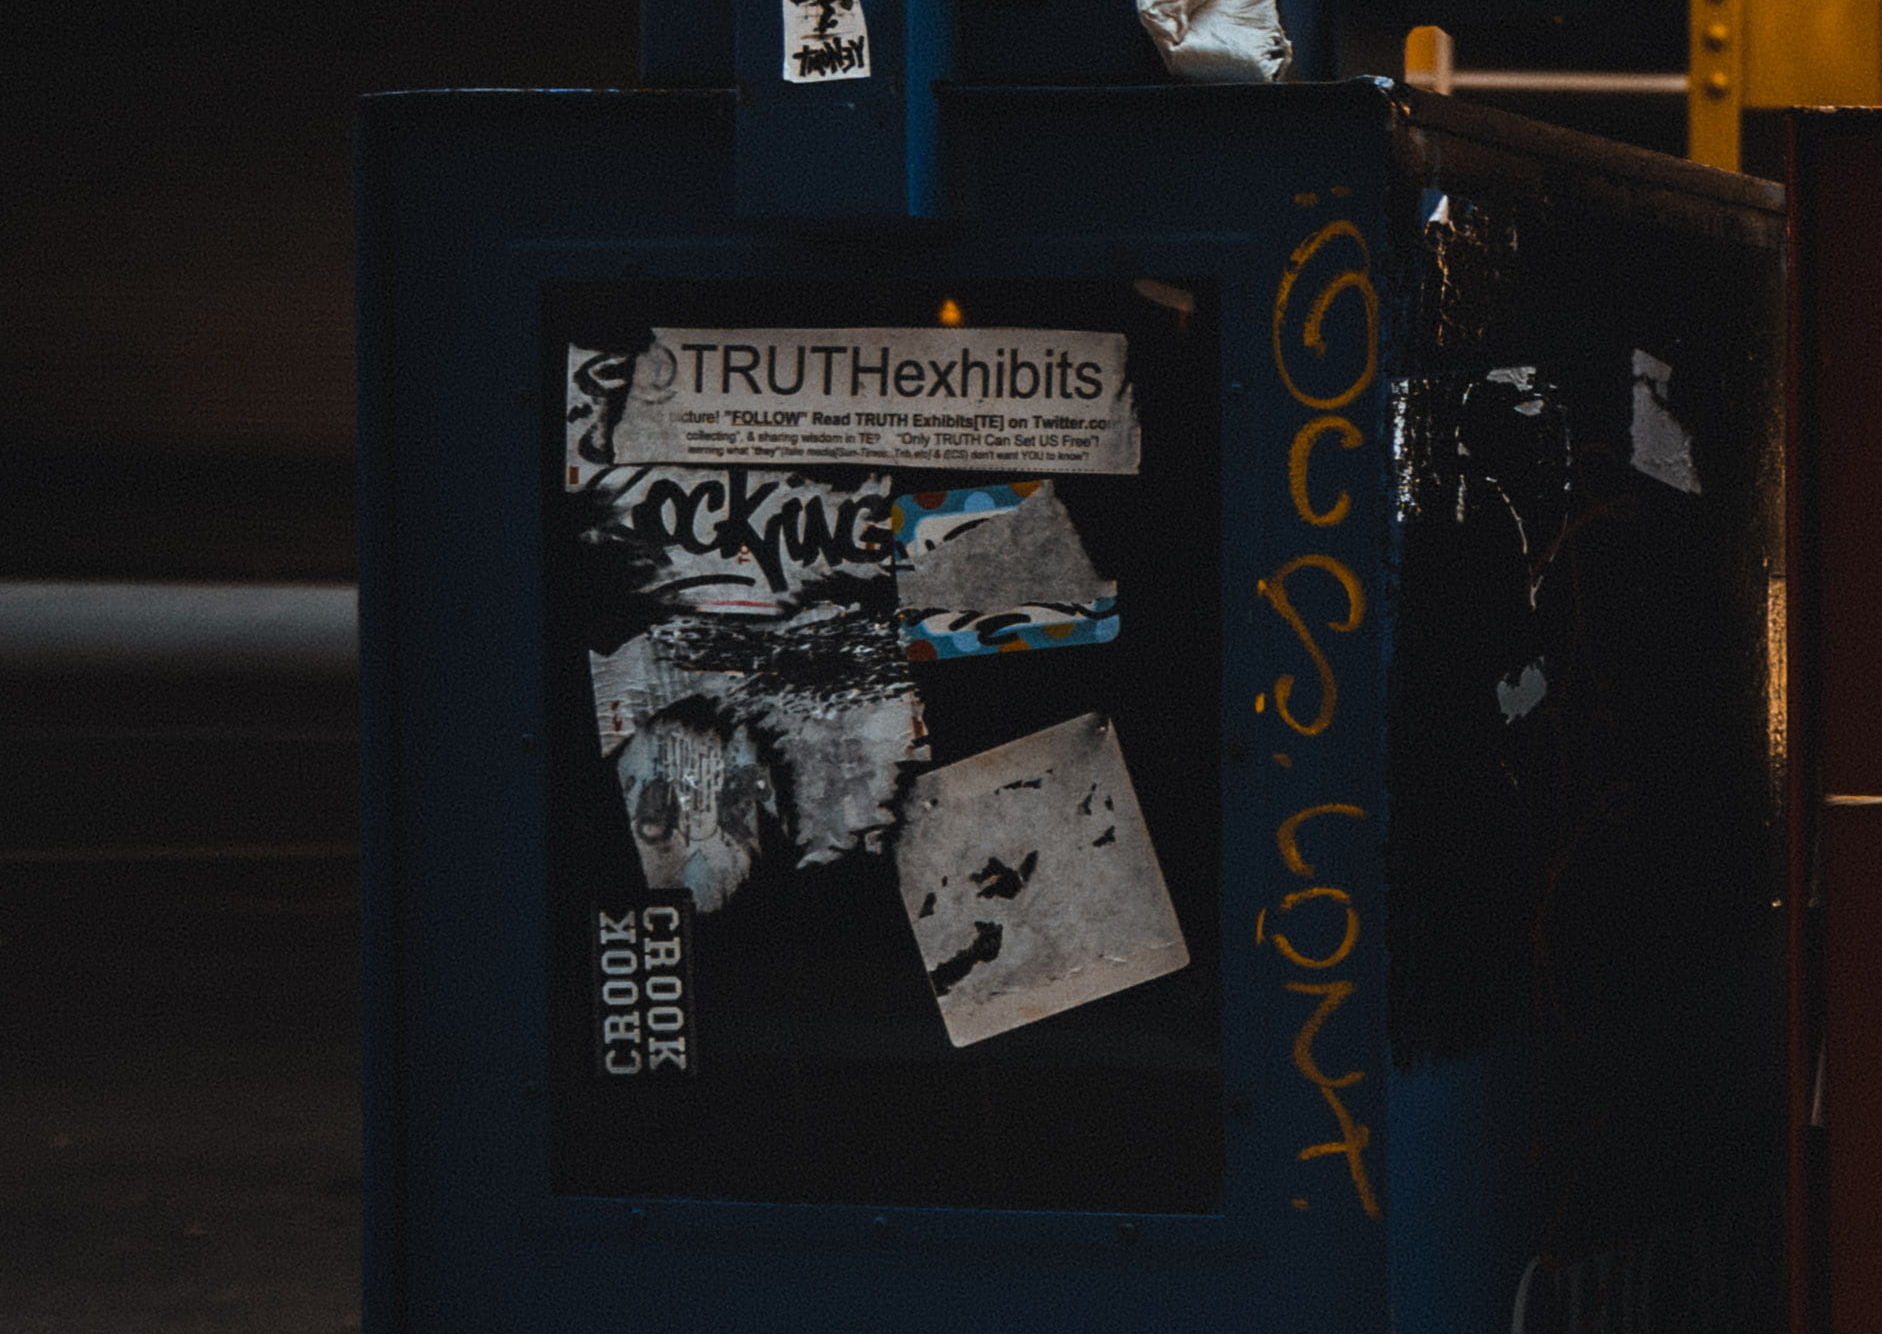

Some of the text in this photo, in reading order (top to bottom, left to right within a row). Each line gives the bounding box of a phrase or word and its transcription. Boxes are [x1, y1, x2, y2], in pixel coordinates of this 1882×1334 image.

[812, 412, 850, 426] Read
[855, 413, 908, 427] TRUTH
[1008, 416, 1028, 429] on
[1032, 415, 1110, 430] Twitter.co
[934, 433, 981, 447] TRUTH
[984, 434, 1009, 447] Can
[1014, 434, 1036, 447] Set
[1038, 435, 1058, 447] US
[600, 911, 643, 1076] CROOK
[642, 904, 688, 1071] CROOK
